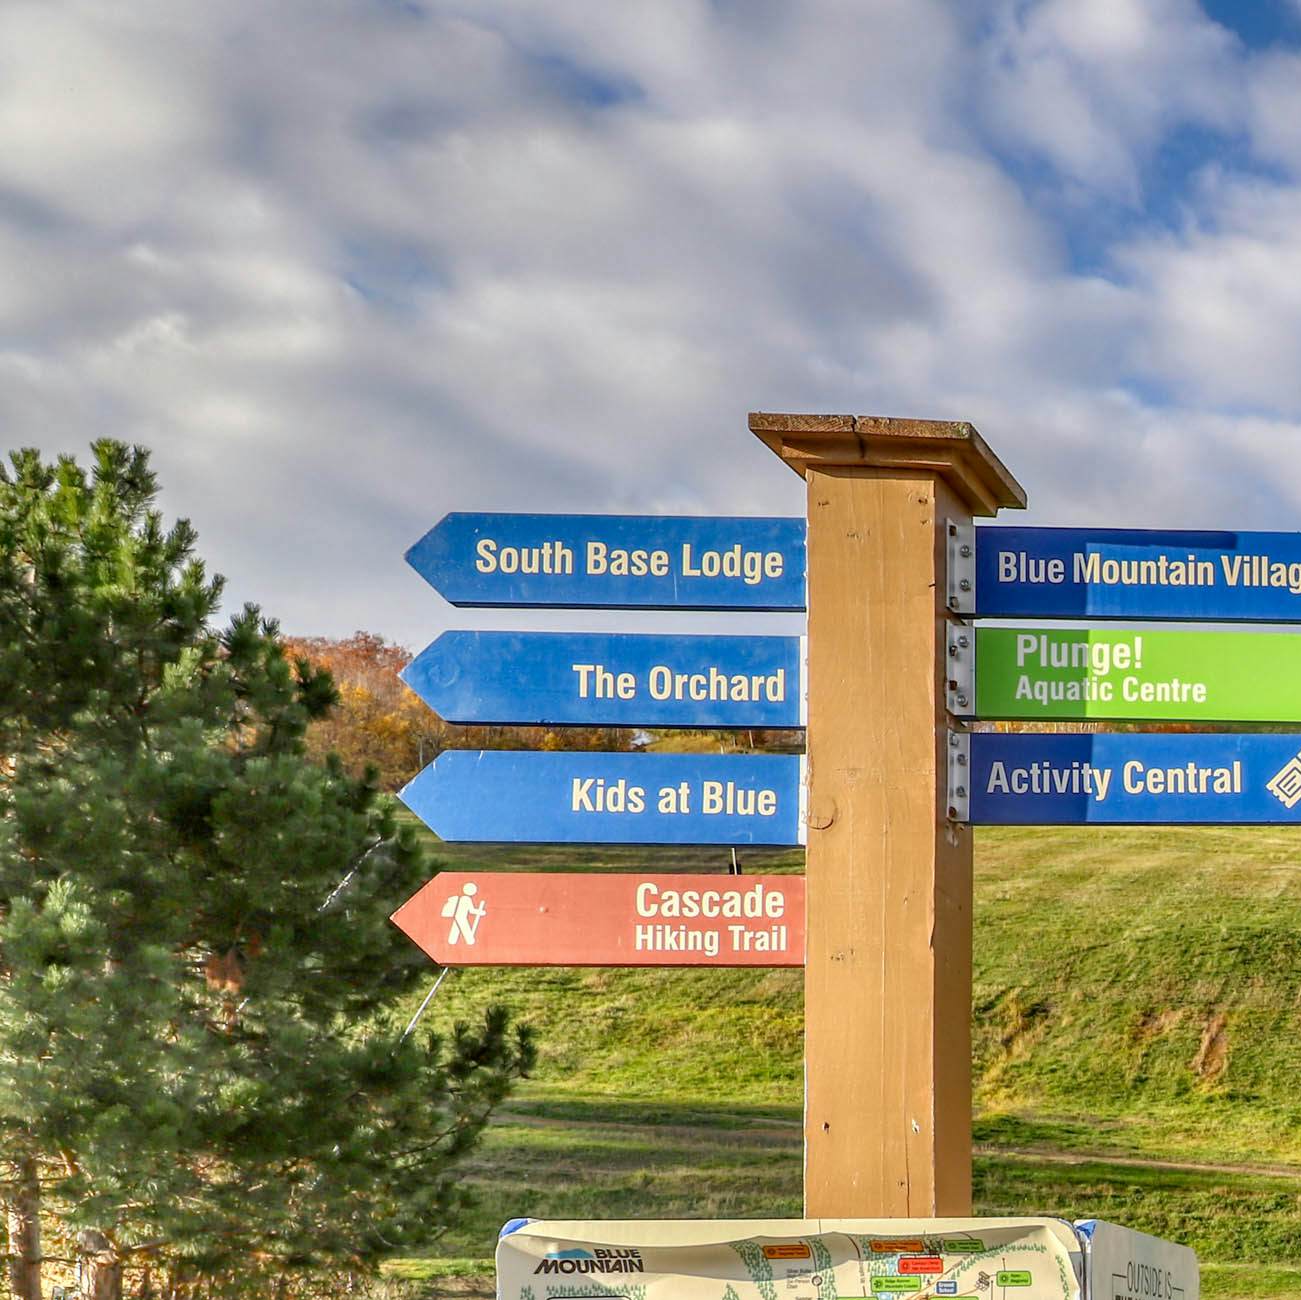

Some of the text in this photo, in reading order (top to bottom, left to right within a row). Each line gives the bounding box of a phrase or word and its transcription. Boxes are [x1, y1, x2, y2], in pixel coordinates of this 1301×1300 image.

[476, 539, 783, 584] South Base Lodge
[999, 552, 1064, 584] Blue
[1074, 553, 1213, 586] Mountain
[1016, 634, 1143, 675] Plunge!
[573, 665, 785, 701] The Orchard
[1016, 675, 1206, 705] Aquatic Centre
[572, 779, 776, 815] Kids at Blue
[987, 761, 1240, 800] Activity Central
[636, 883, 784, 918] Cascade
[635, 925, 786, 956] Hiking Trail
[534, 1259, 644, 1274] MOUNTAIN
[594, 1249, 641, 1258] BLUE
[1127, 1261, 1172, 1300] OUTSIDE IS
